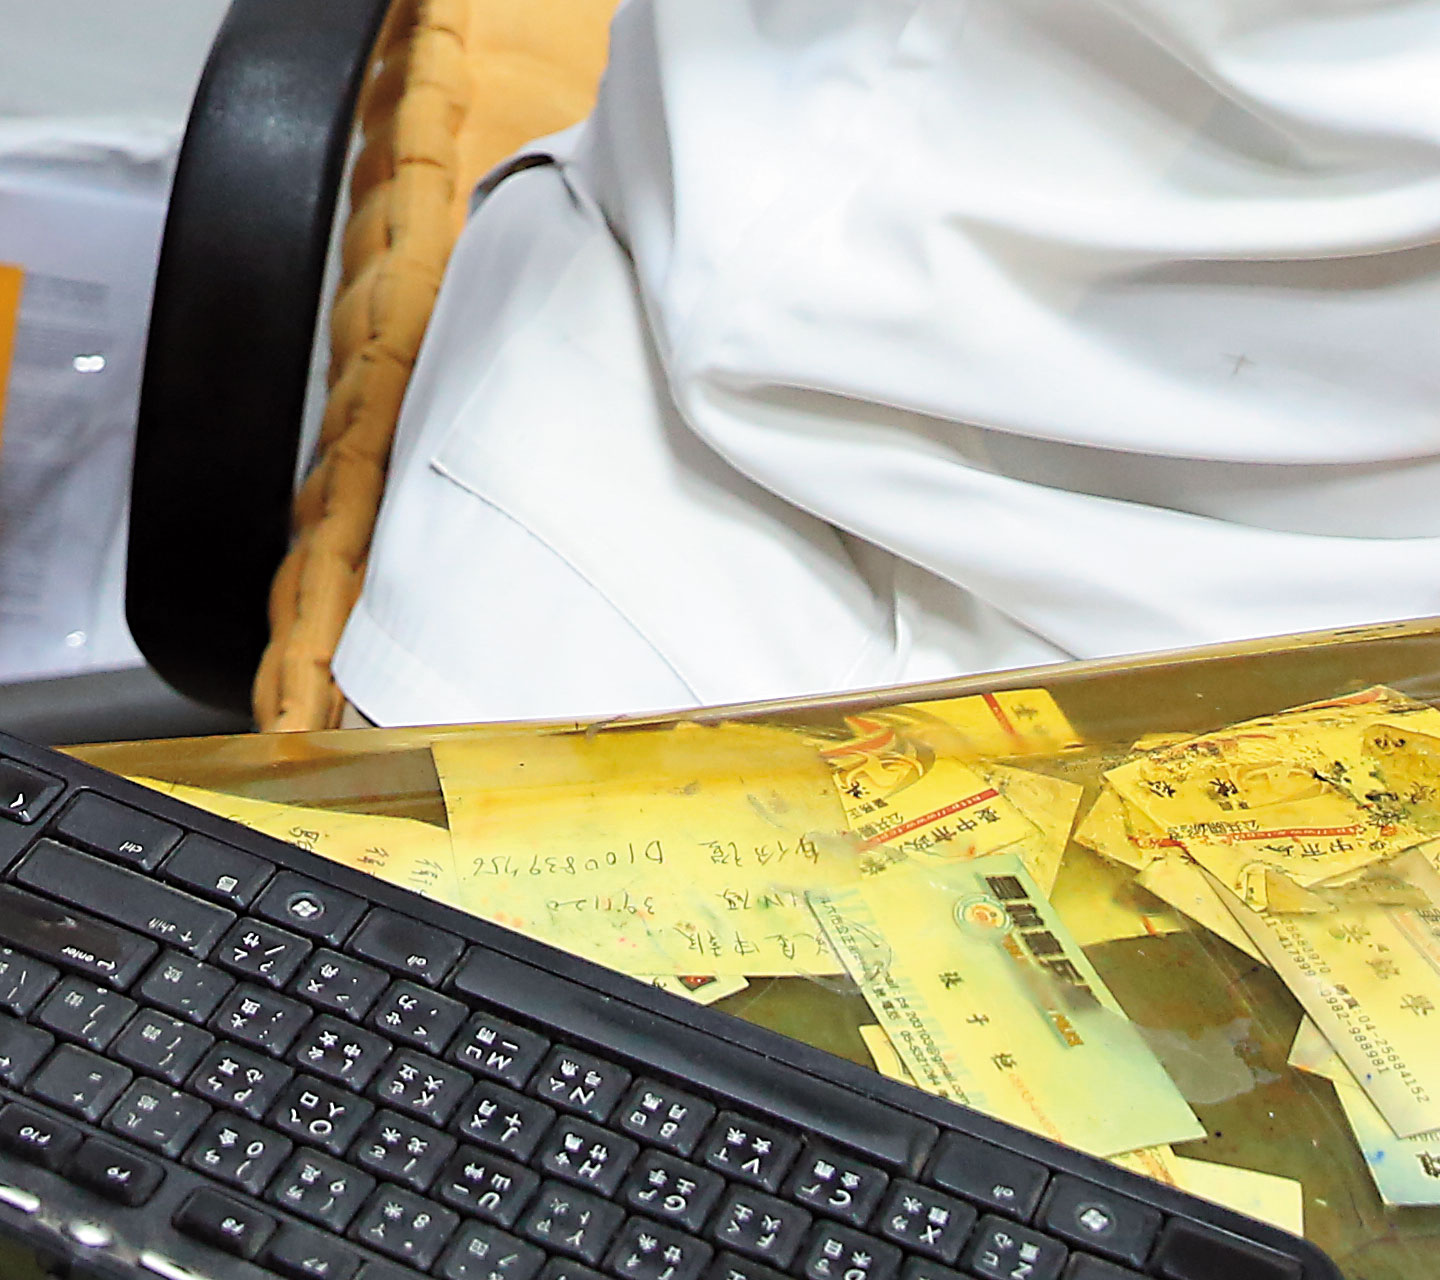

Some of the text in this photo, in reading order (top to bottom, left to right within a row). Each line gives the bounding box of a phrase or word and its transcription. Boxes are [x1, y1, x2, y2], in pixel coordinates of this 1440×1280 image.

[119, 841, 143, 853] ctrl
[148, 918, 176, 933] shift
[61, 946, 94, 962] enter
[343, 1044, 361, 1057] 中
[486, 1051, 512, 1071] M
[234, 1088, 252, 1103] P
[412, 1090, 434, 1107] K
[569, 1086, 595, 1105] N
[20, 1127, 51, 1144] F10
[500, 1126, 519, 1142] J
[660, 1122, 678, 1138] B
[246, 1142, 264, 1156] 0
[107, 1167, 131, 1180] F9
[578, 1160, 602, 1179] H
[741, 1158, 760, 1175] V
[478, 1192, 500, 1210] U
[663, 1195, 686, 1212] G
[828, 1189, 851, 1207] C
[413, 1214, 430, 1229] 8
[919, 1225, 942, 1245] X
